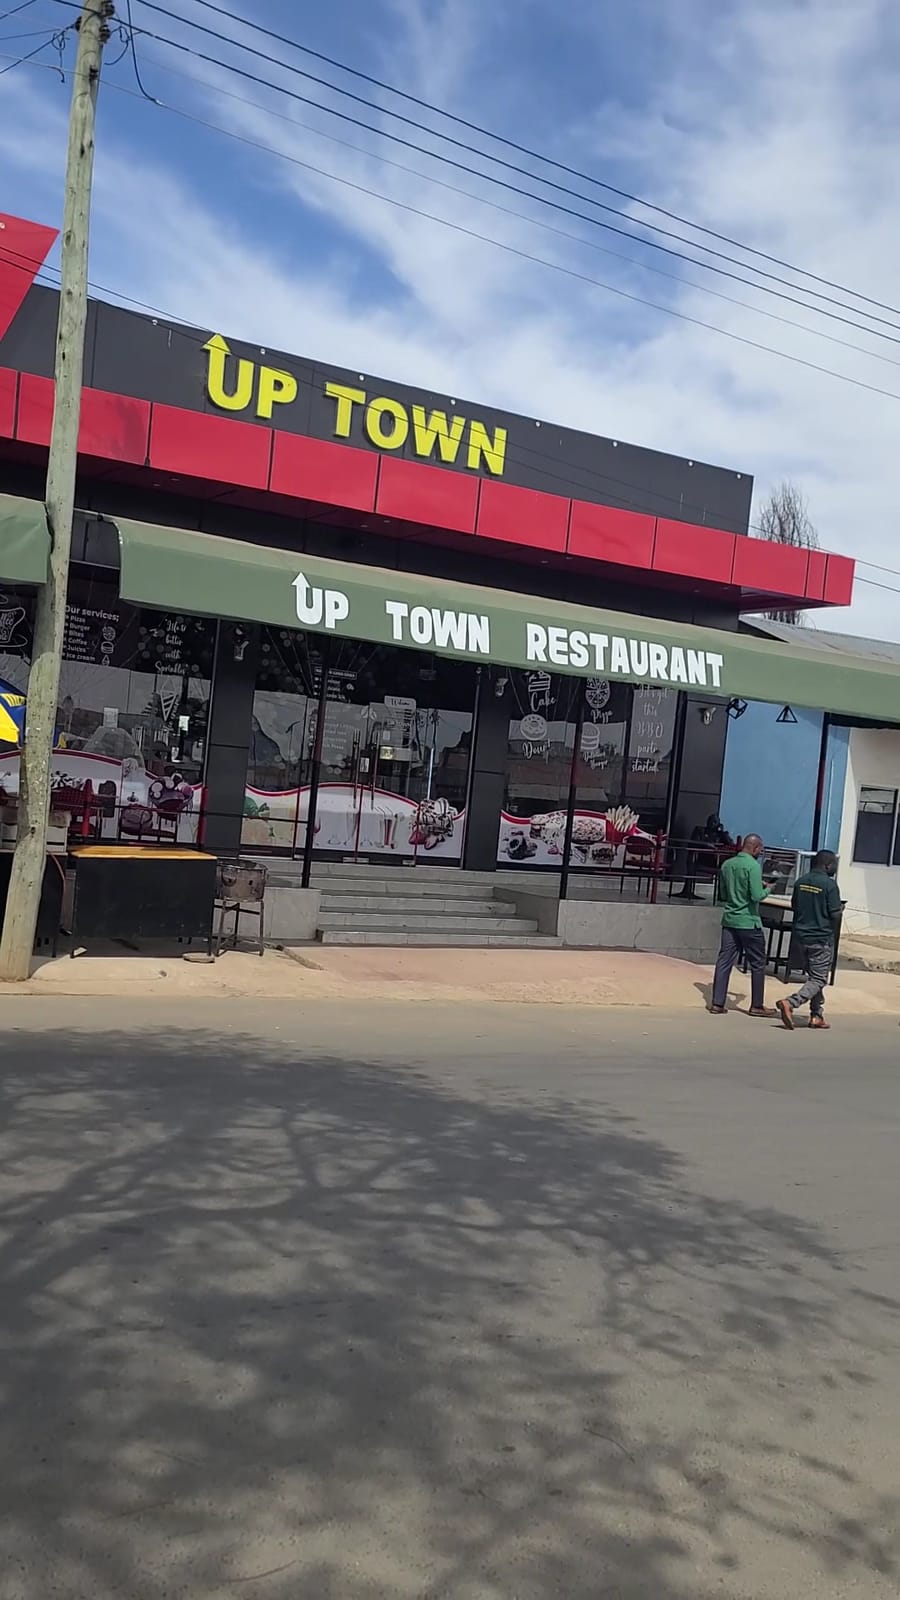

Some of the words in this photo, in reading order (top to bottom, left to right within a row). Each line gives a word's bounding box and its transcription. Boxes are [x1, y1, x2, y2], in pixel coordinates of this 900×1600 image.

[202, 333, 298, 419] UP
[325, 381, 507, 475] TOWN
[69, 622, 91, 632] Burger
[70, 615, 86, 623] Pizza
[291, 572, 349, 629] UP
[385, 600, 490, 655] TOWN
[526, 623, 723, 688] RESTAURANT
[67, 637, 88, 646] Coffee
[530, 690, 557, 712] Cake
